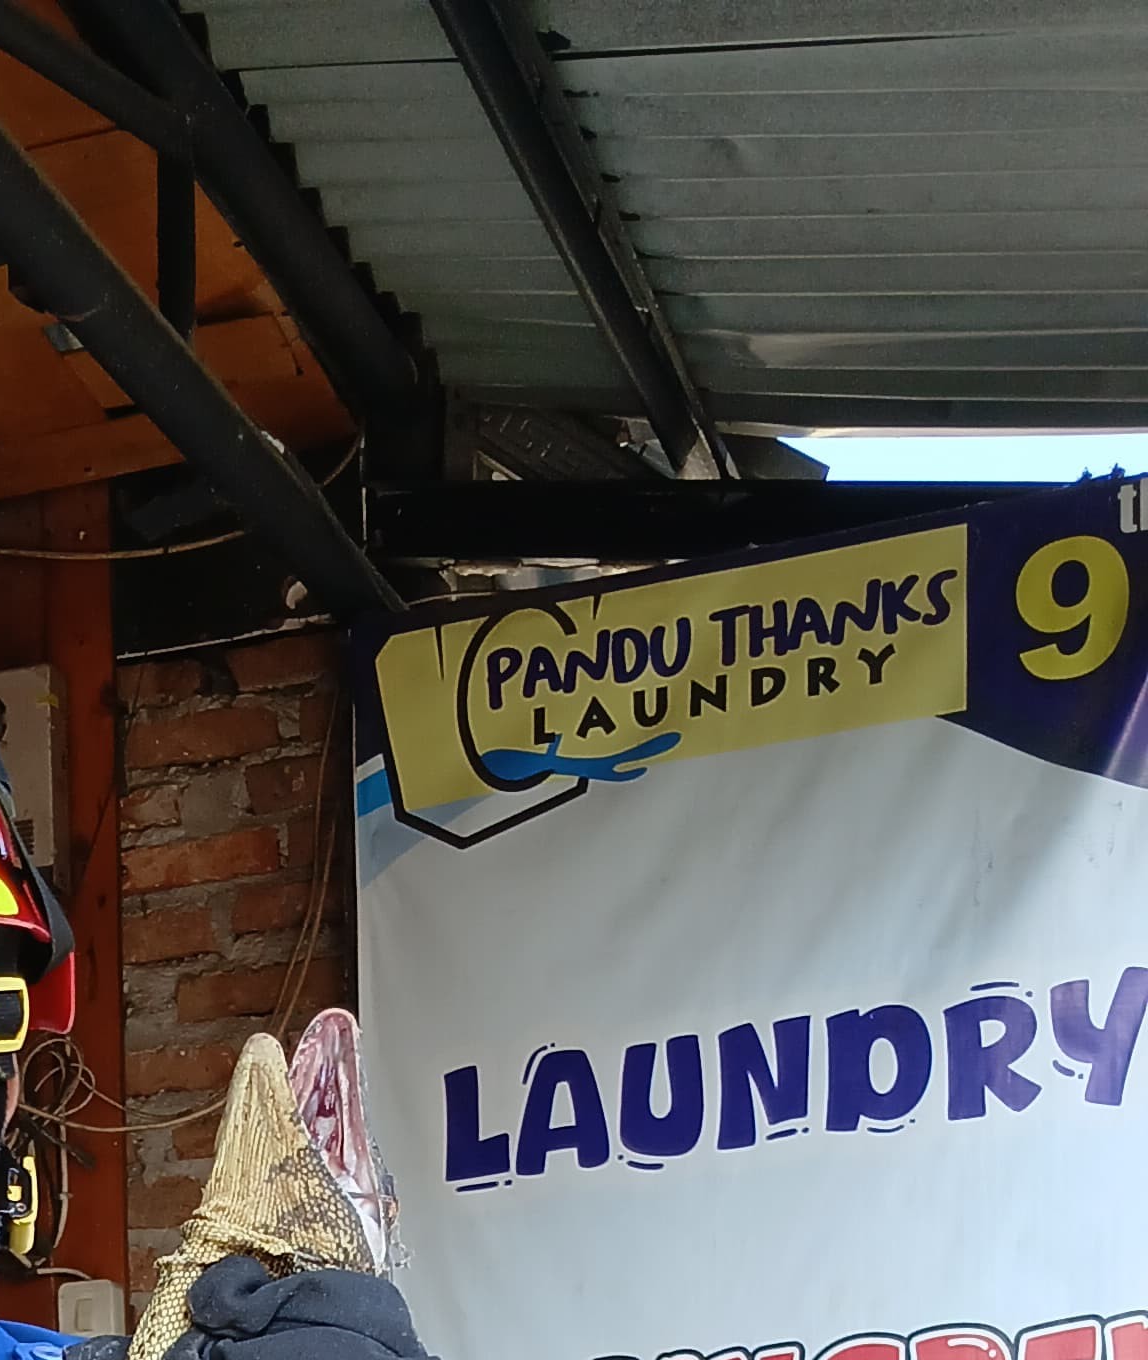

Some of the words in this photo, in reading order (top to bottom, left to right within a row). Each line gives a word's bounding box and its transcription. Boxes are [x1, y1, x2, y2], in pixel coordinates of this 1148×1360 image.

[485, 617, 692, 710] PANDU
[708, 569, 958, 666] THANKS
[532, 643, 897, 745] LAUNDRY
[442, 966, 1148, 1193] LAUNDRY
